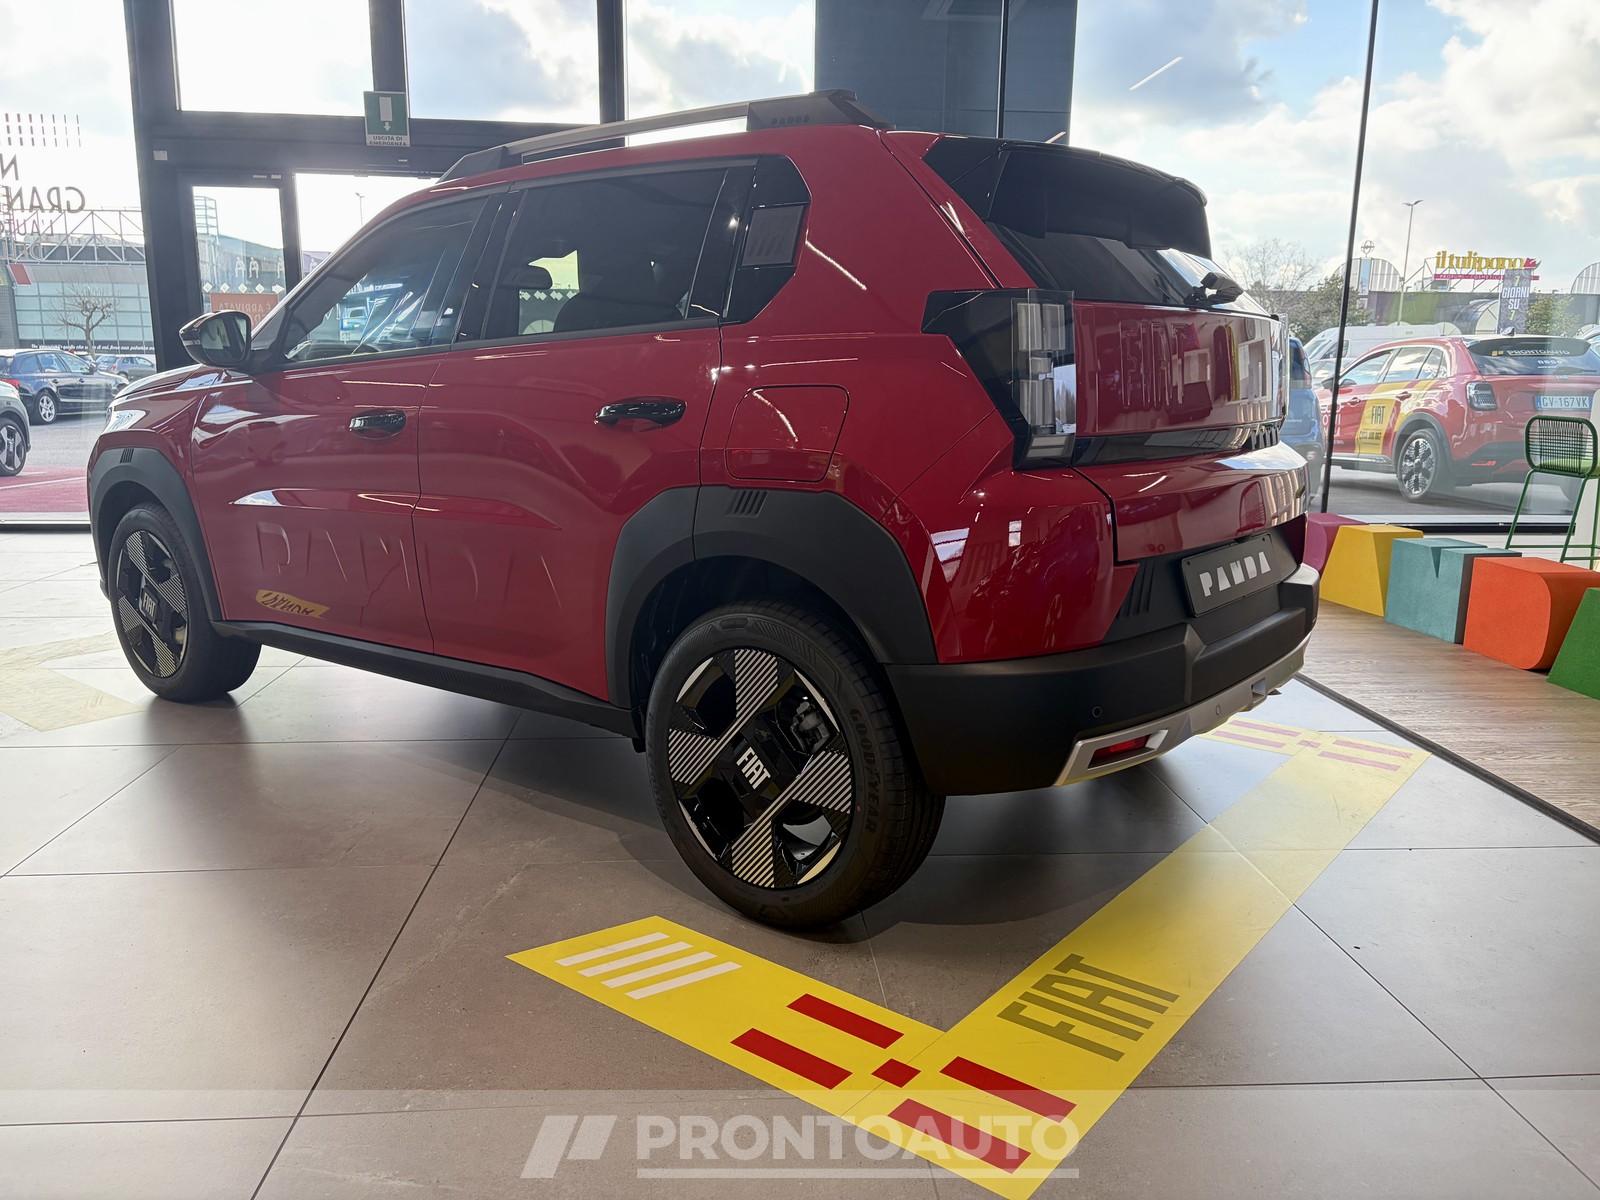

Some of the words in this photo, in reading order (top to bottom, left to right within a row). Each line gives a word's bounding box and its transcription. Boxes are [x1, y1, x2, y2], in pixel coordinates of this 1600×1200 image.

[1436, 251, 1447, 269] il
[1449, 250, 1525, 272] tulipano
[1502, 287, 1529, 298] GIORNI
[1508, 299, 1520, 309] SU
[1119, 321, 1187, 408] FIAT
[1371, 405, 1385, 424] FIAT
[1559, 397, 1588, 407] 167VK
[1199, 551, 1271, 597] PANDA
[143, 592, 156, 617] FIAT
[736, 746, 771, 790] FIAT
[849, 708, 881, 833] GOODYEAR
[997, 953, 1180, 1062] FIAT
